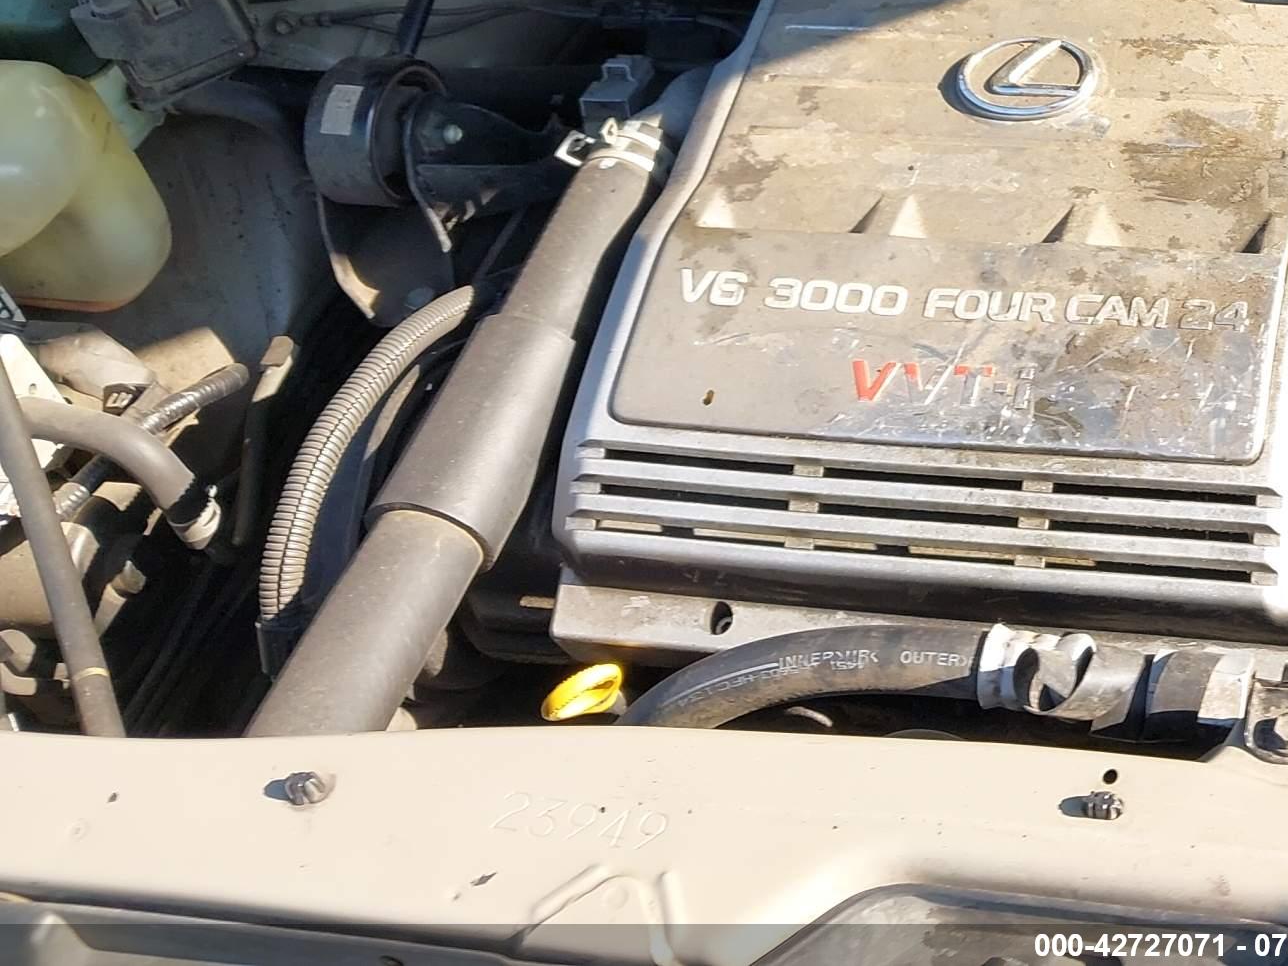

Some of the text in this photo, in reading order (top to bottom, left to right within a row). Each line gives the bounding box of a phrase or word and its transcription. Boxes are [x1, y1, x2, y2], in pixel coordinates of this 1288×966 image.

[679, 268, 1250, 333] V6 3000 FOUR CAM 24
[489, 791, 669, 851] 23949
